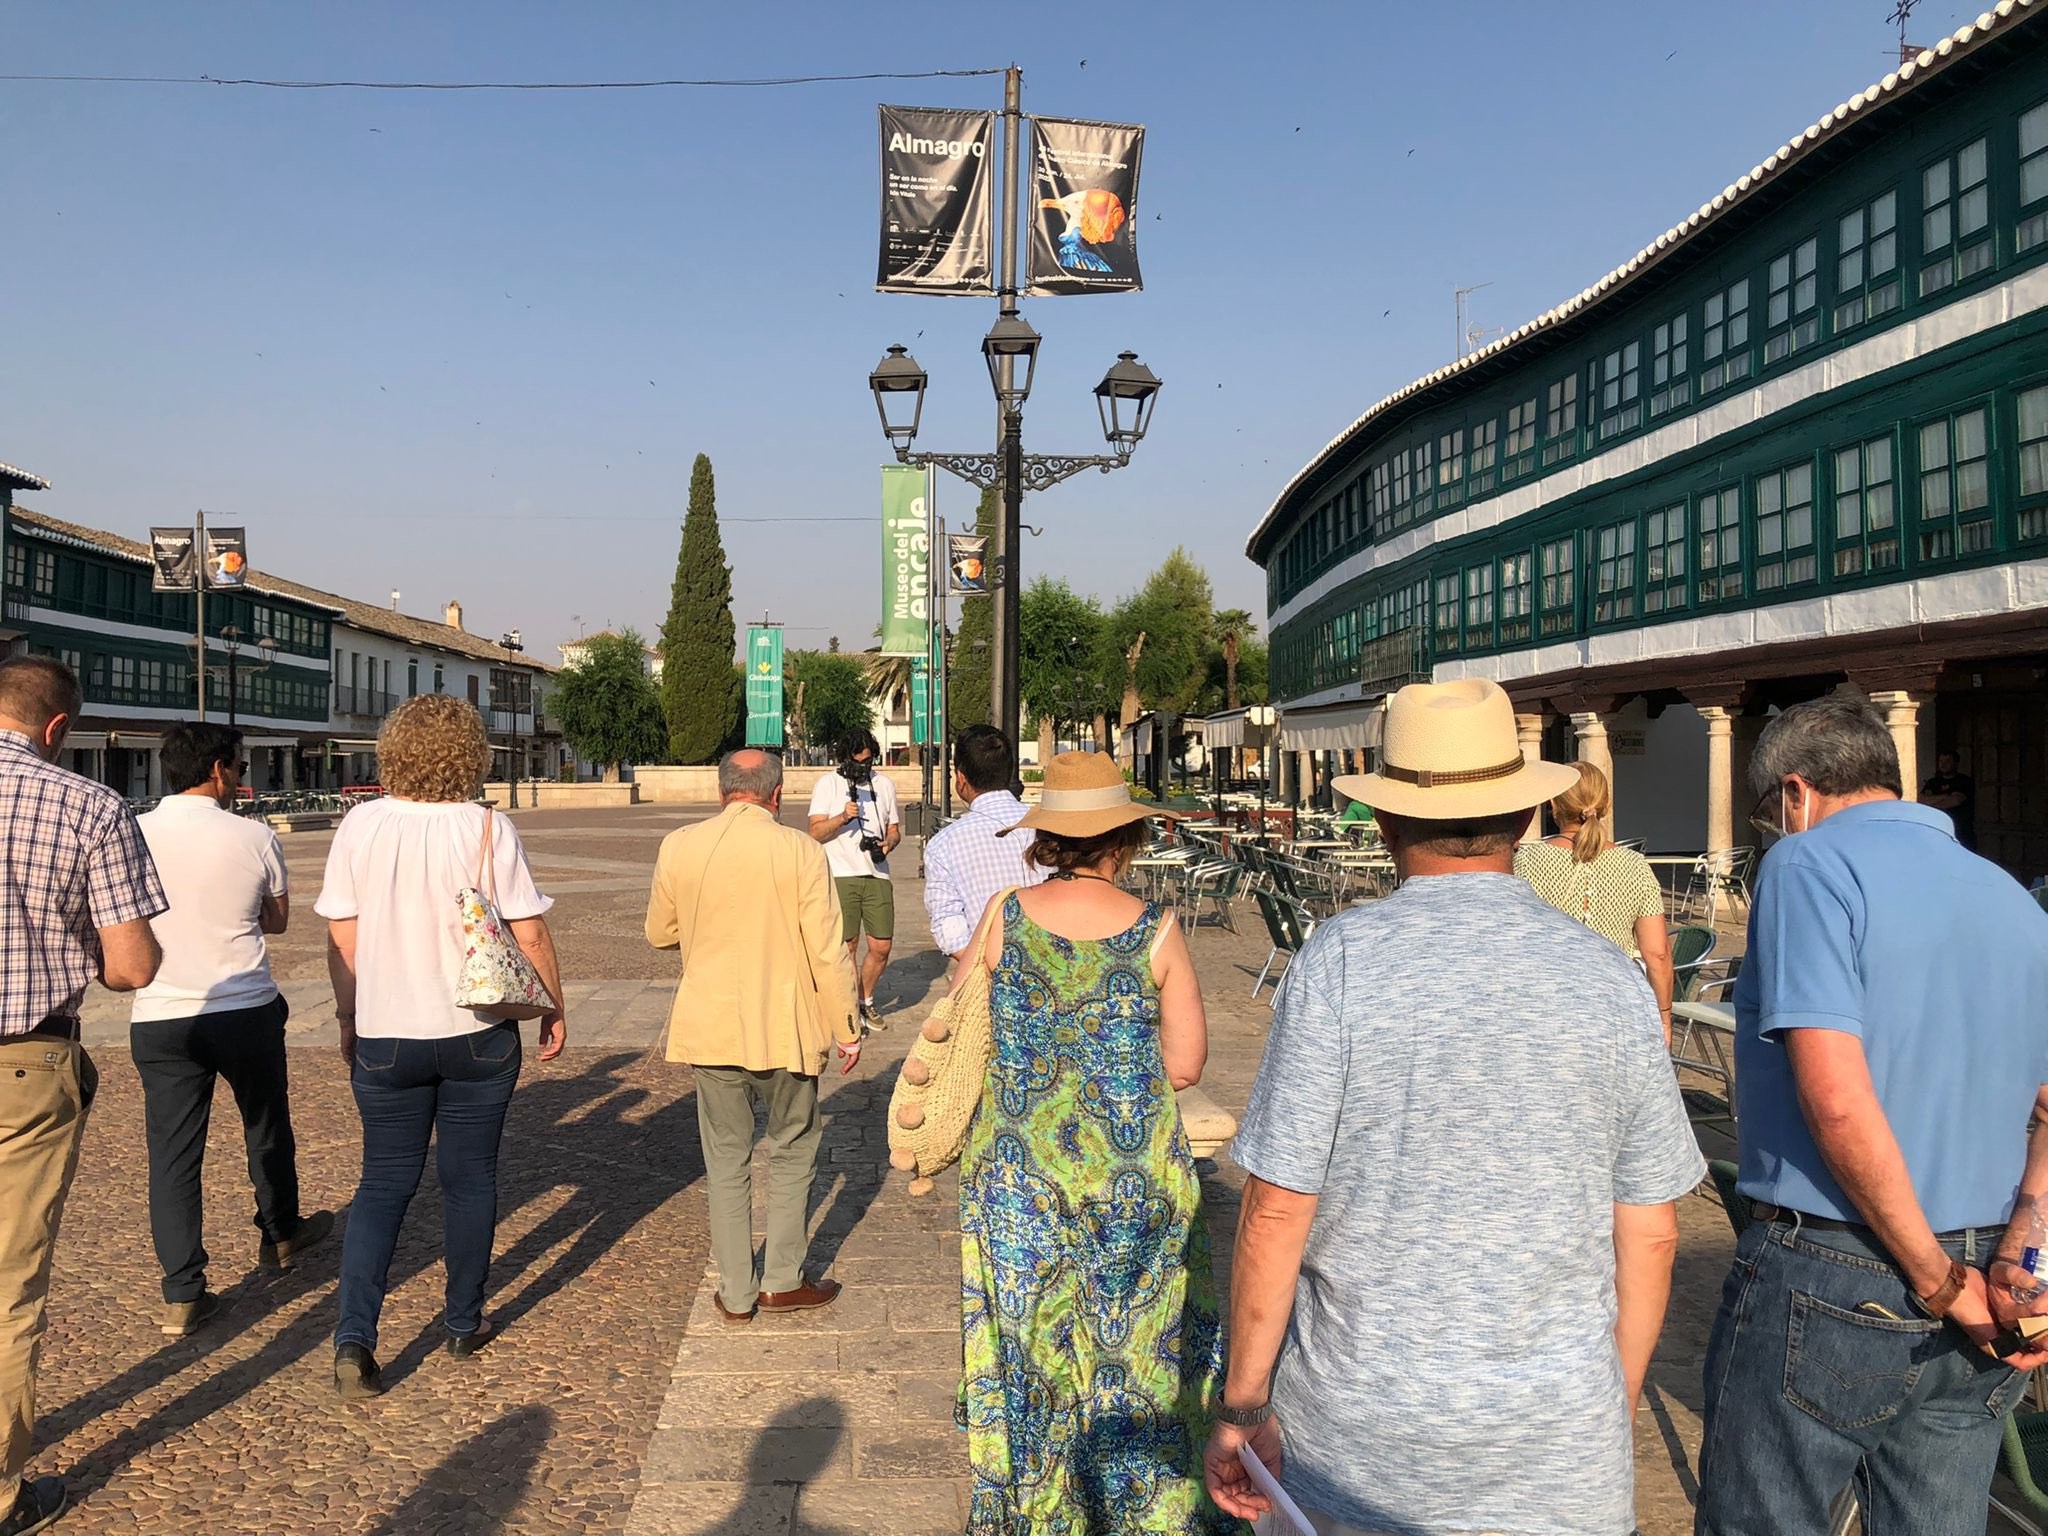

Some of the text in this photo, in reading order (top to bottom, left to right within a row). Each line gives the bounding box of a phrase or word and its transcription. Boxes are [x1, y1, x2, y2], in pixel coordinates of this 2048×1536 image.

[889, 132, 986, 160] Almagro
[154, 536, 191, 546] Almagro
[888, 497, 927, 619] encaje
[893, 533, 908, 619] Museo del
